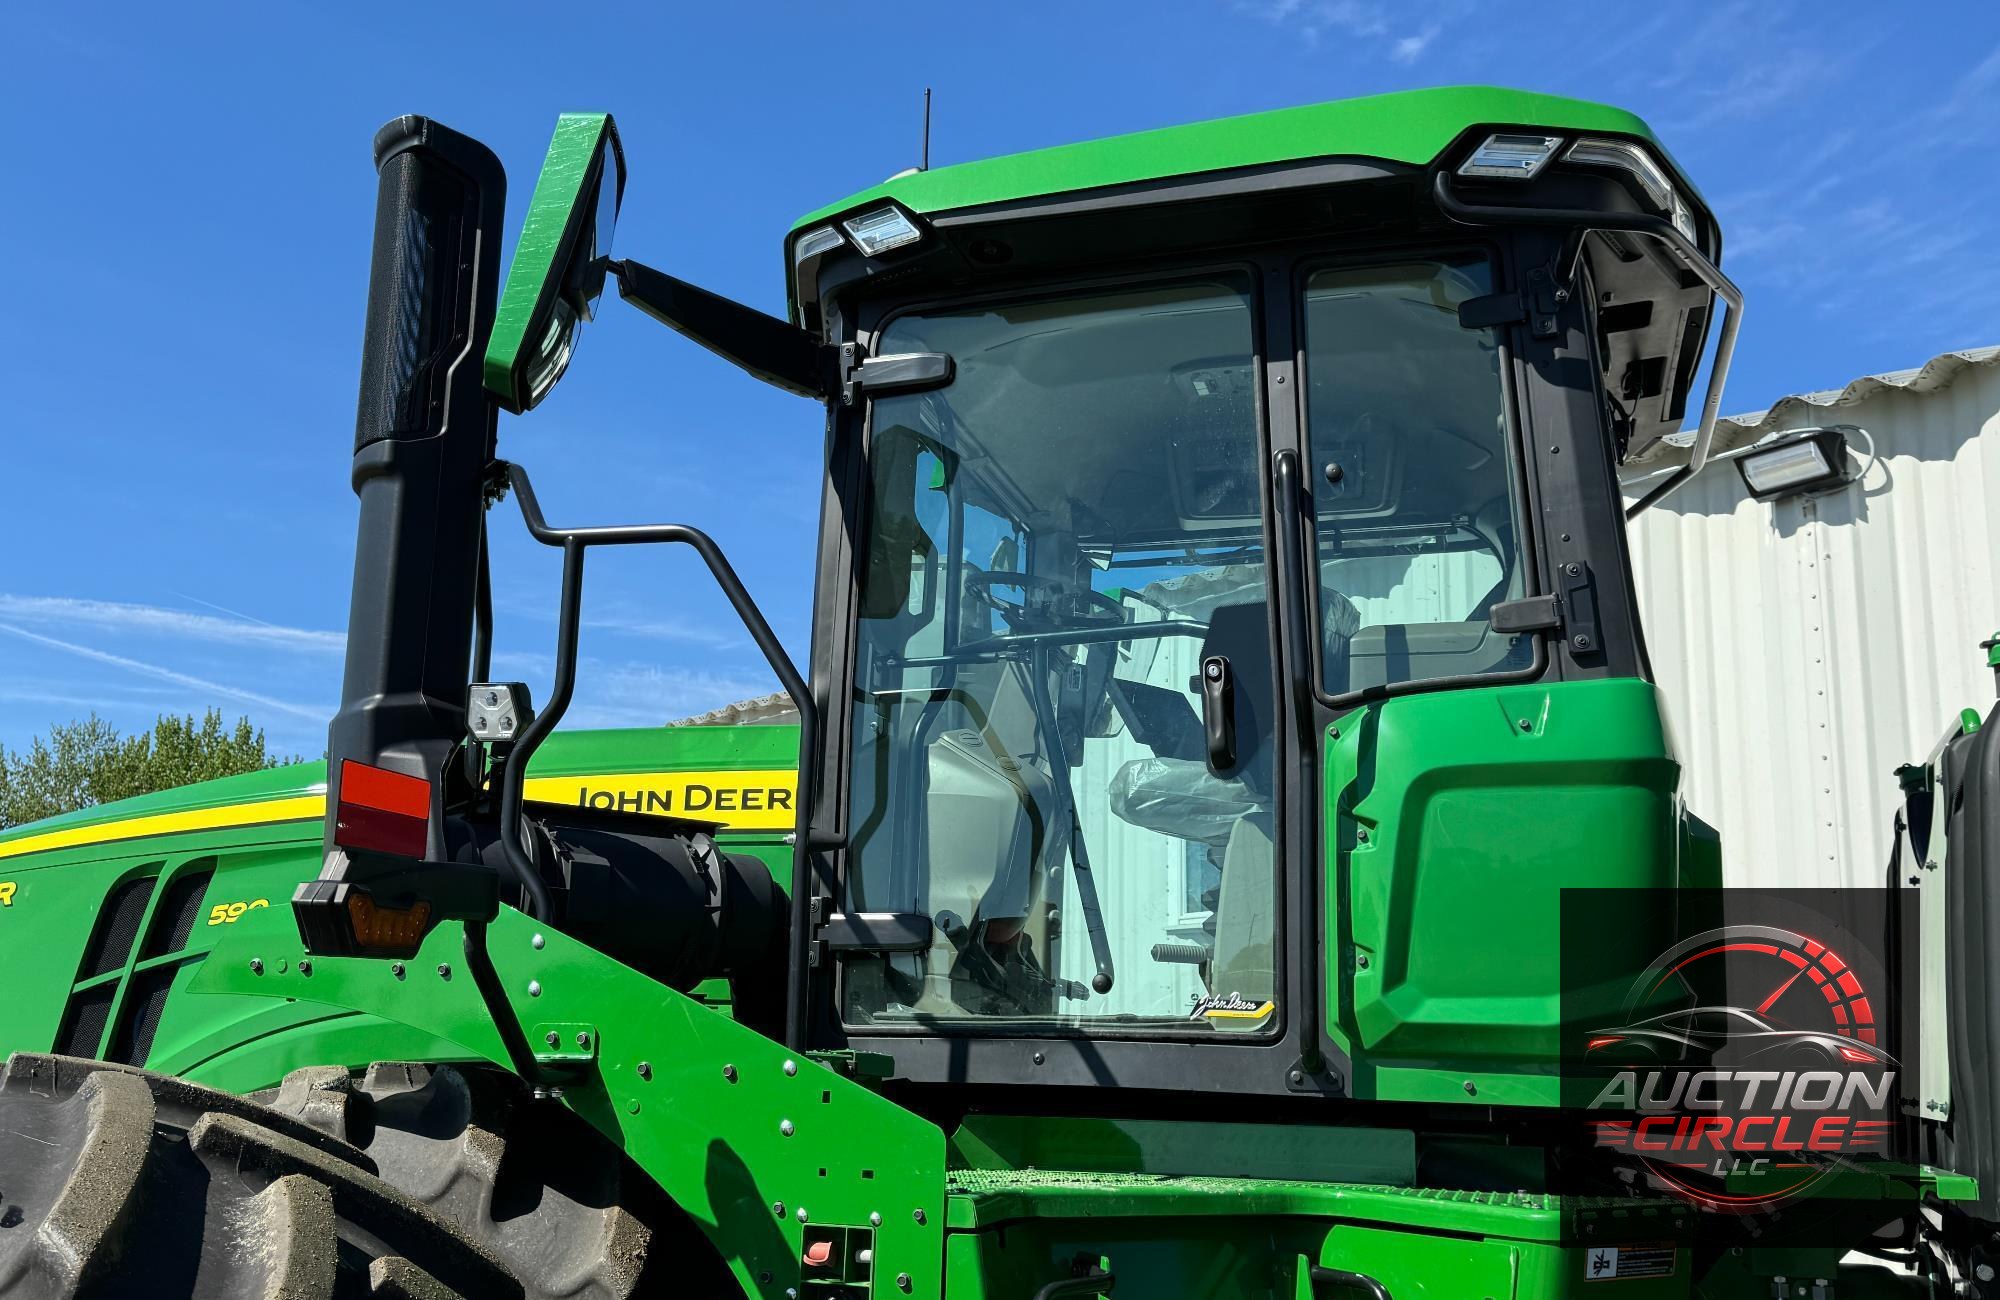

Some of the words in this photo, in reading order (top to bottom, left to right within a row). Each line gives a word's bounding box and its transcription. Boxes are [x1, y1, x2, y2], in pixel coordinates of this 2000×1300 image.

[579, 787, 672, 812] JOHN
[684, 784, 793, 811] DEER
[1190, 993, 1226, 1020] John
